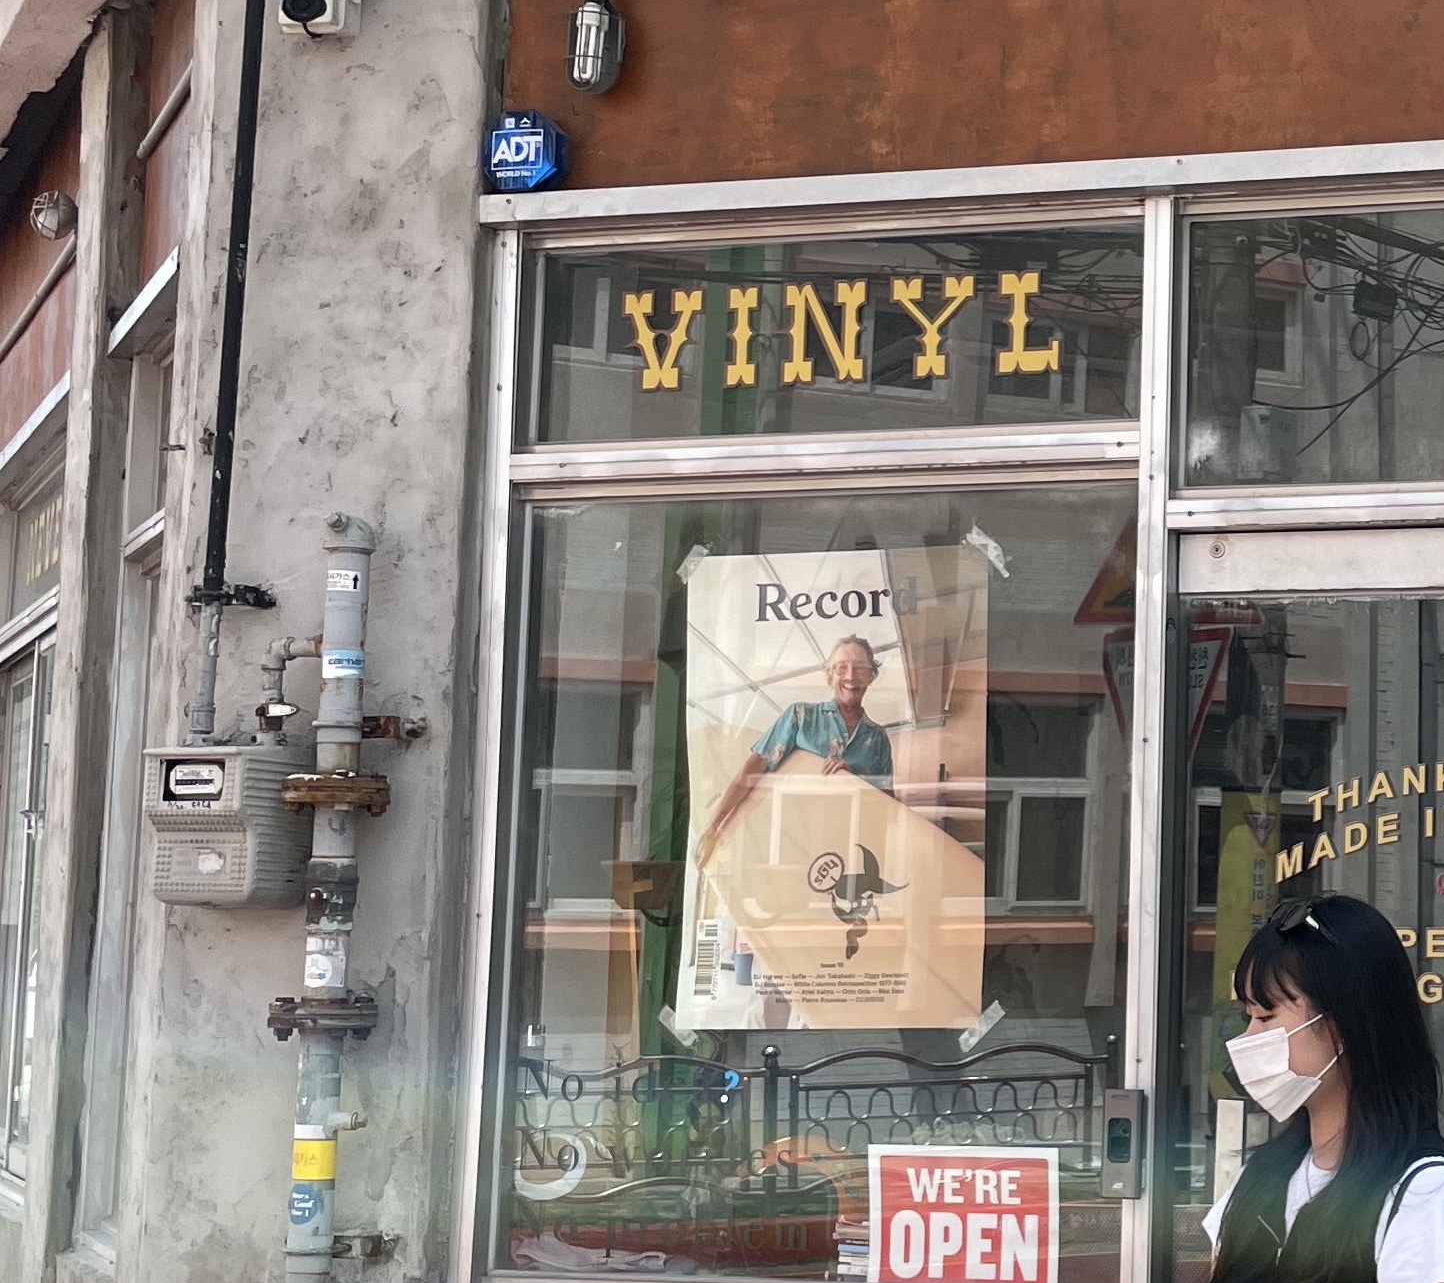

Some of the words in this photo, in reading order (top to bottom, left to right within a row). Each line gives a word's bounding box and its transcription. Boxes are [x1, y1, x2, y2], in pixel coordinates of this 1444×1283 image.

[492, 135, 543, 164] ADT
[620, 268, 1061, 393] VINYL
[1275, 811, 1401, 885] MADE
[888, 1210, 1040, 1283] OPEN
